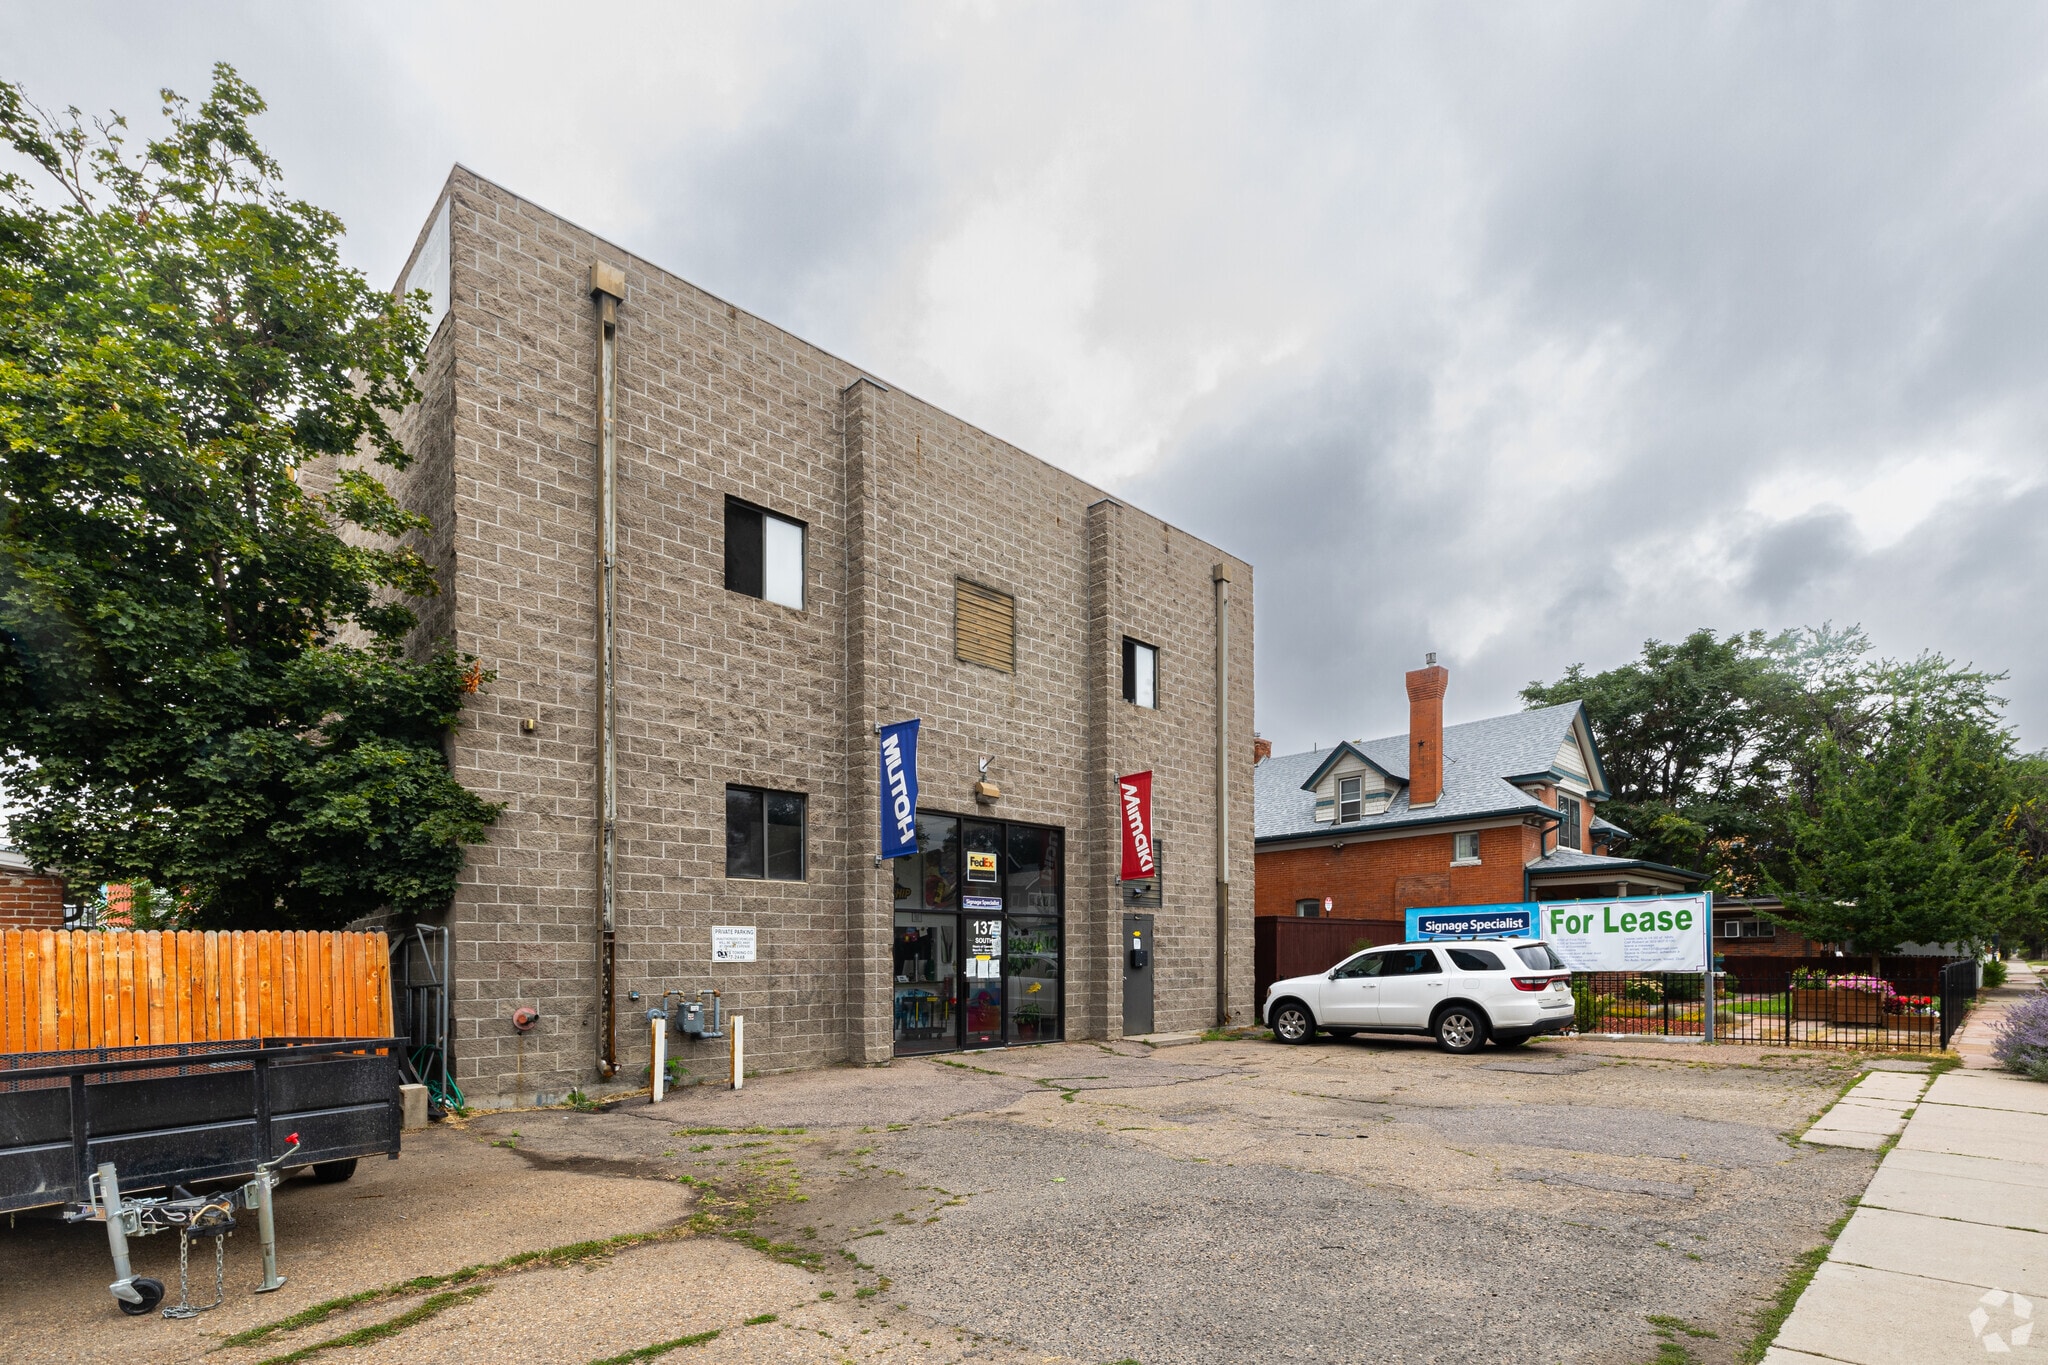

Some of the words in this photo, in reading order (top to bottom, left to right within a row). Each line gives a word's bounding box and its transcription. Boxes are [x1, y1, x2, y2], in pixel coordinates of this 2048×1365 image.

[882, 733, 914, 844] MUTOH
[1121, 783, 1154, 872] Mimaki
[970, 856, 994, 868] FedEx
[973, 920, 993, 935] 137
[1425, 921, 1468, 933] Signage
[1470, 918, 1523, 932] Specialist
[1550, 909, 1594, 935] For
[1603, 906, 1693, 933] Lease
